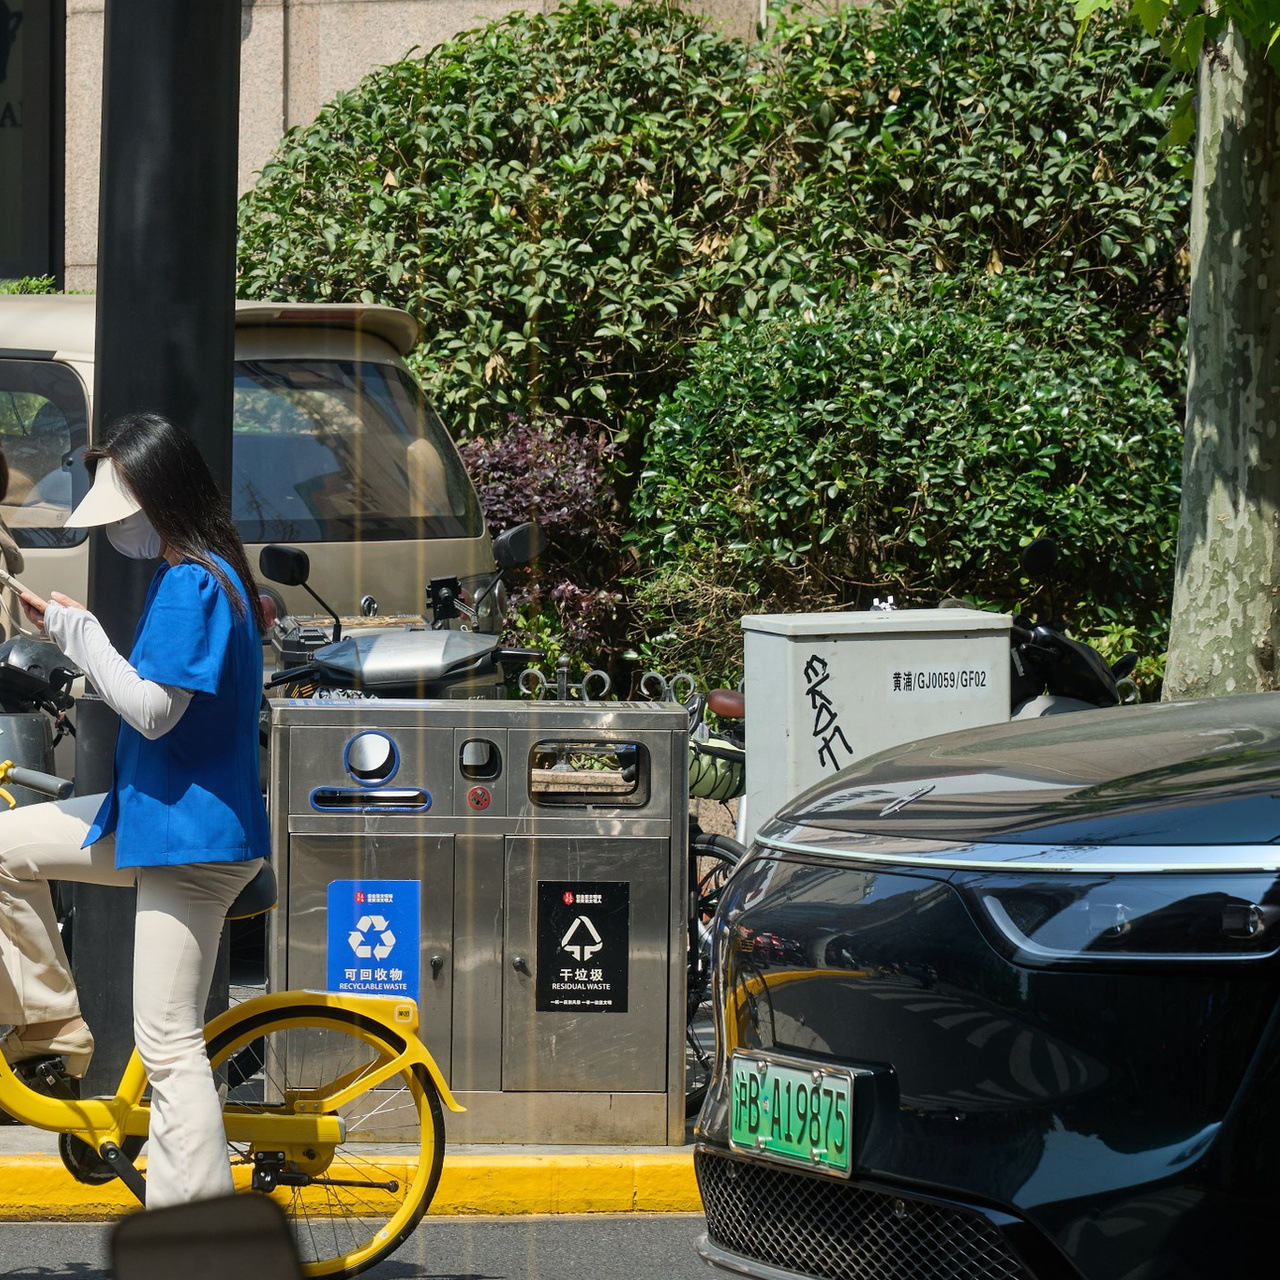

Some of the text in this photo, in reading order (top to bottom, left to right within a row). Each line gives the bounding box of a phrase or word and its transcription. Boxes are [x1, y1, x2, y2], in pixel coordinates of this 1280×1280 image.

[892, 670, 987, 692] 黄浦/GJ0059/GF02
[343, 968, 404, 982] 可回收物
[559, 968, 604, 982] 干垃圾
[339, 982, 408, 991] RECYCLABLE WASTE
[551, 982, 611, 991] RESIDUAL WASTE
